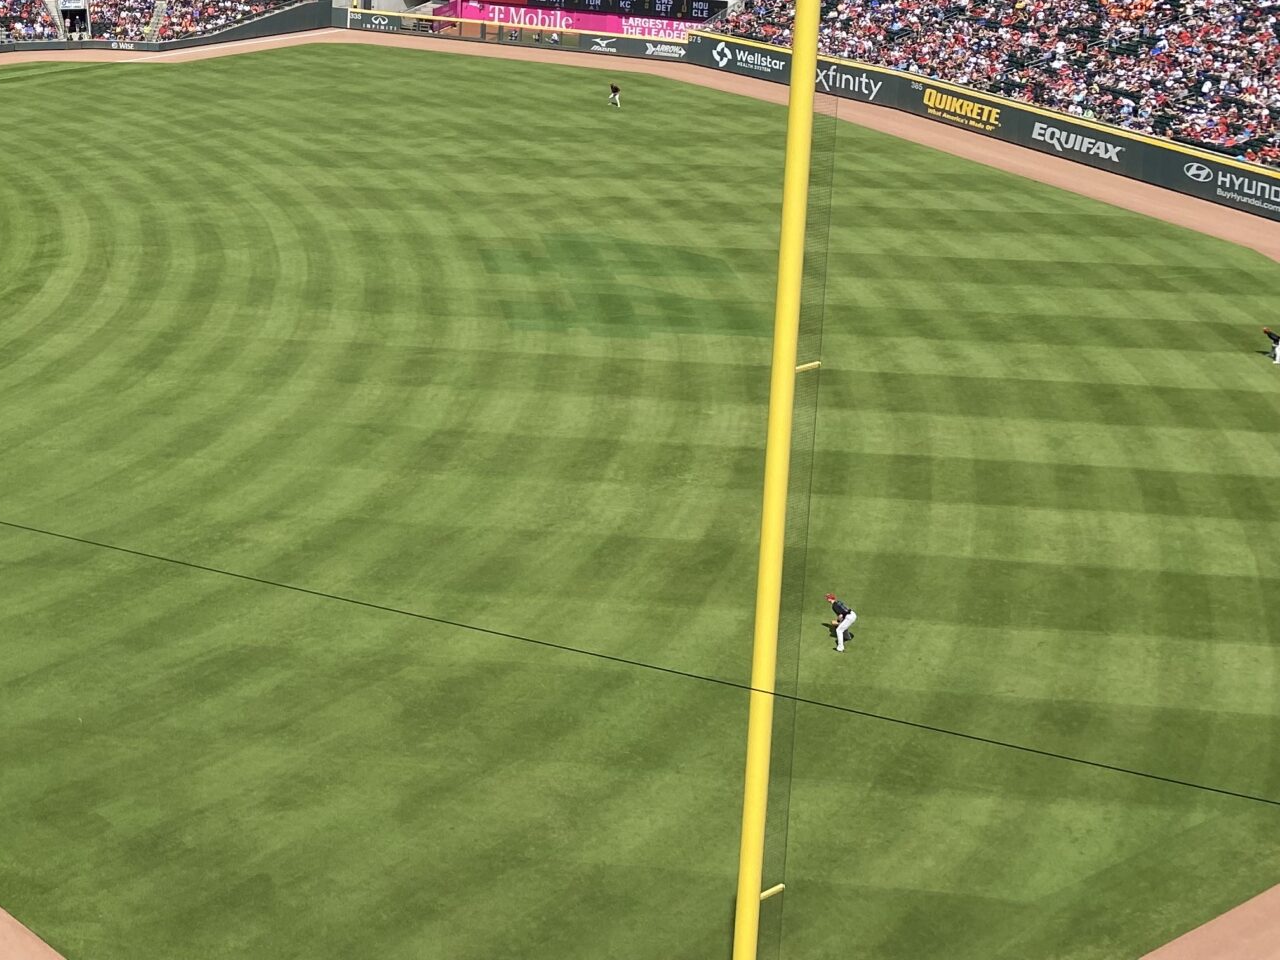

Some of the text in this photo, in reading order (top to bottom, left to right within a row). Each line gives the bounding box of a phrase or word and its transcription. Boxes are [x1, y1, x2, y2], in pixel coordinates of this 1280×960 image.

[620, 1, 631, 9] KC
[656, 4, 672, 12] DET
[692, 2, 708, 10] HOU
[622, 17, 670, 29] LARGEST.
[622, 26, 643, 36] THE
[735, 49, 786, 71] Wellstar
[737, 61, 771, 72] HEALTH SYSTEM
[814, 66, 883, 100] xfinity
[923, 88, 1000, 124] QUIKRETE
[928, 108, 941, 116] What
[942, 112, 968, 124] America's
[969, 120, 984, 128] Made
[1032, 122, 1120, 162] EQUIFAX
